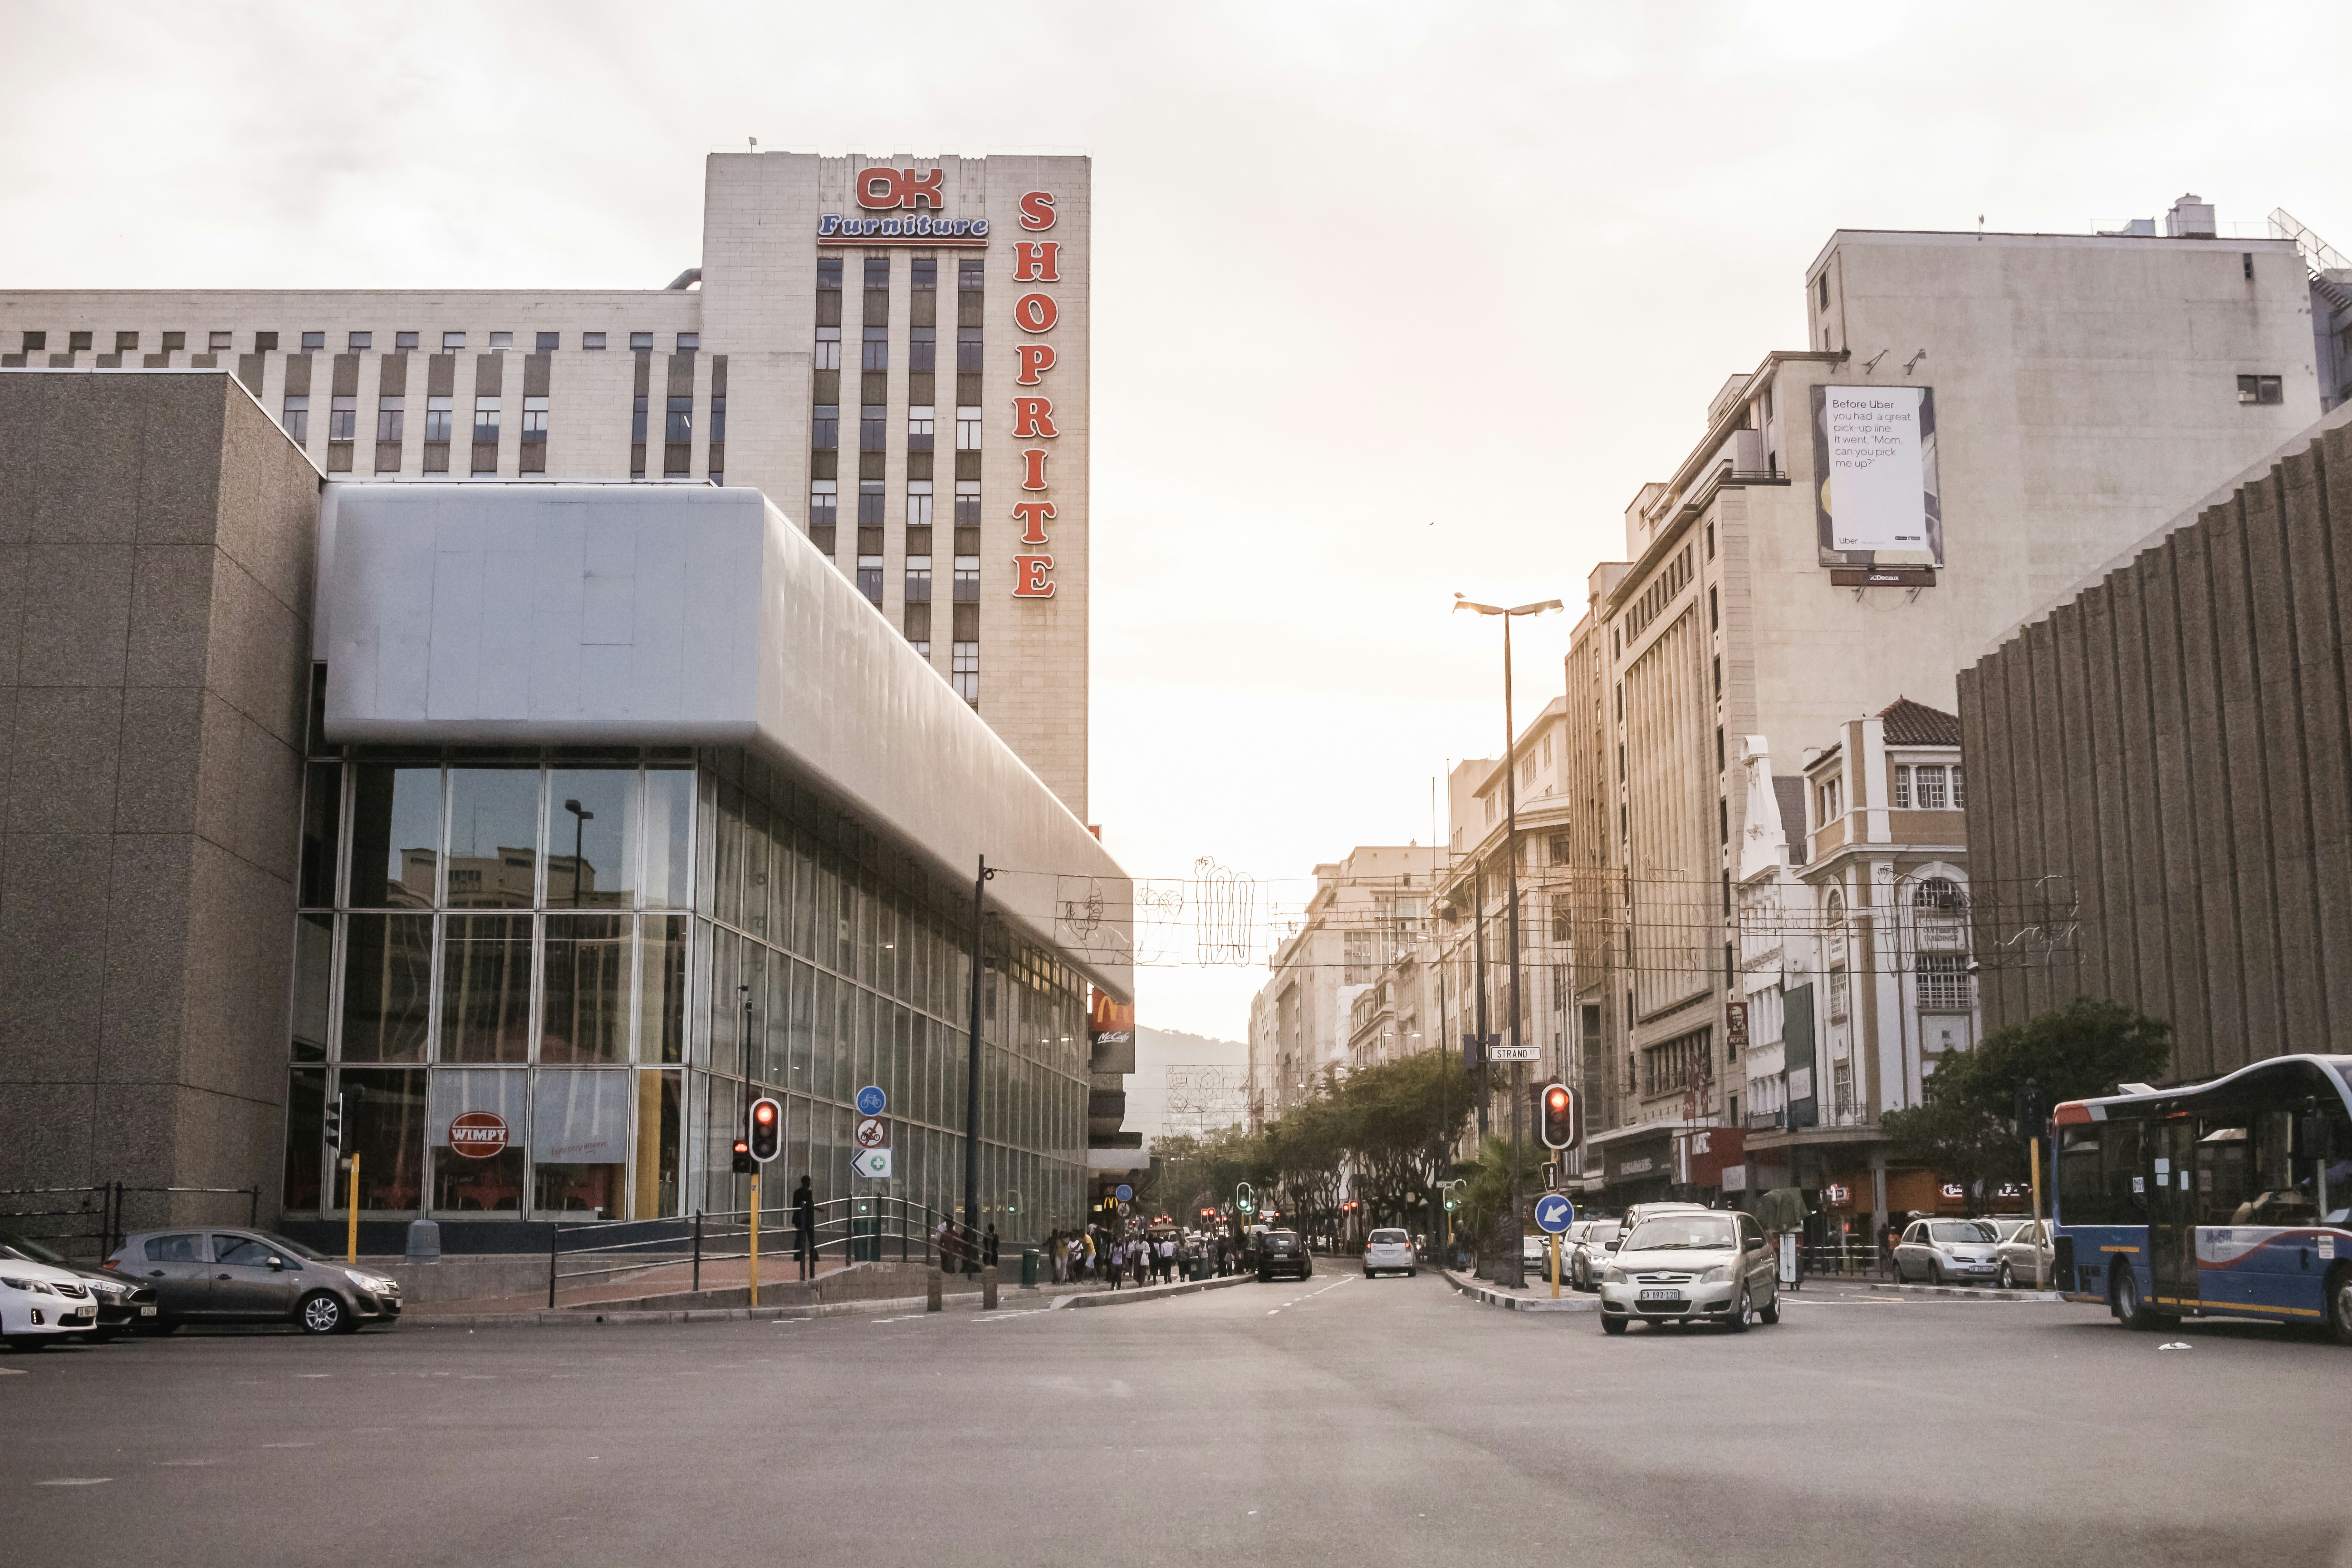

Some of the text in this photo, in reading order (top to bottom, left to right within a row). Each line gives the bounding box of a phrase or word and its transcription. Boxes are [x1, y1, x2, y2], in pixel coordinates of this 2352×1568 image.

[856, 167, 944, 209] OK
[818, 213, 990, 236] Furniture
[1012, 191, 1061, 598] SHOPRITE
[1833, 399, 1894, 409] Before Uber
[1833, 413, 1851, 422] you
[1854, 412, 1872, 421] had
[1885, 413, 1911, 422] great
[1834, 423, 1872, 434] pick-up
[1835, 435, 1840, 443] It
[1842, 436, 1869, 445] went,
[1855, 449, 1873, 457] you
[1876, 447, 1896, 457] pick
[1497, 1049, 1527, 1058] STRAND
[452, 1129, 506, 1141] WIMPY
